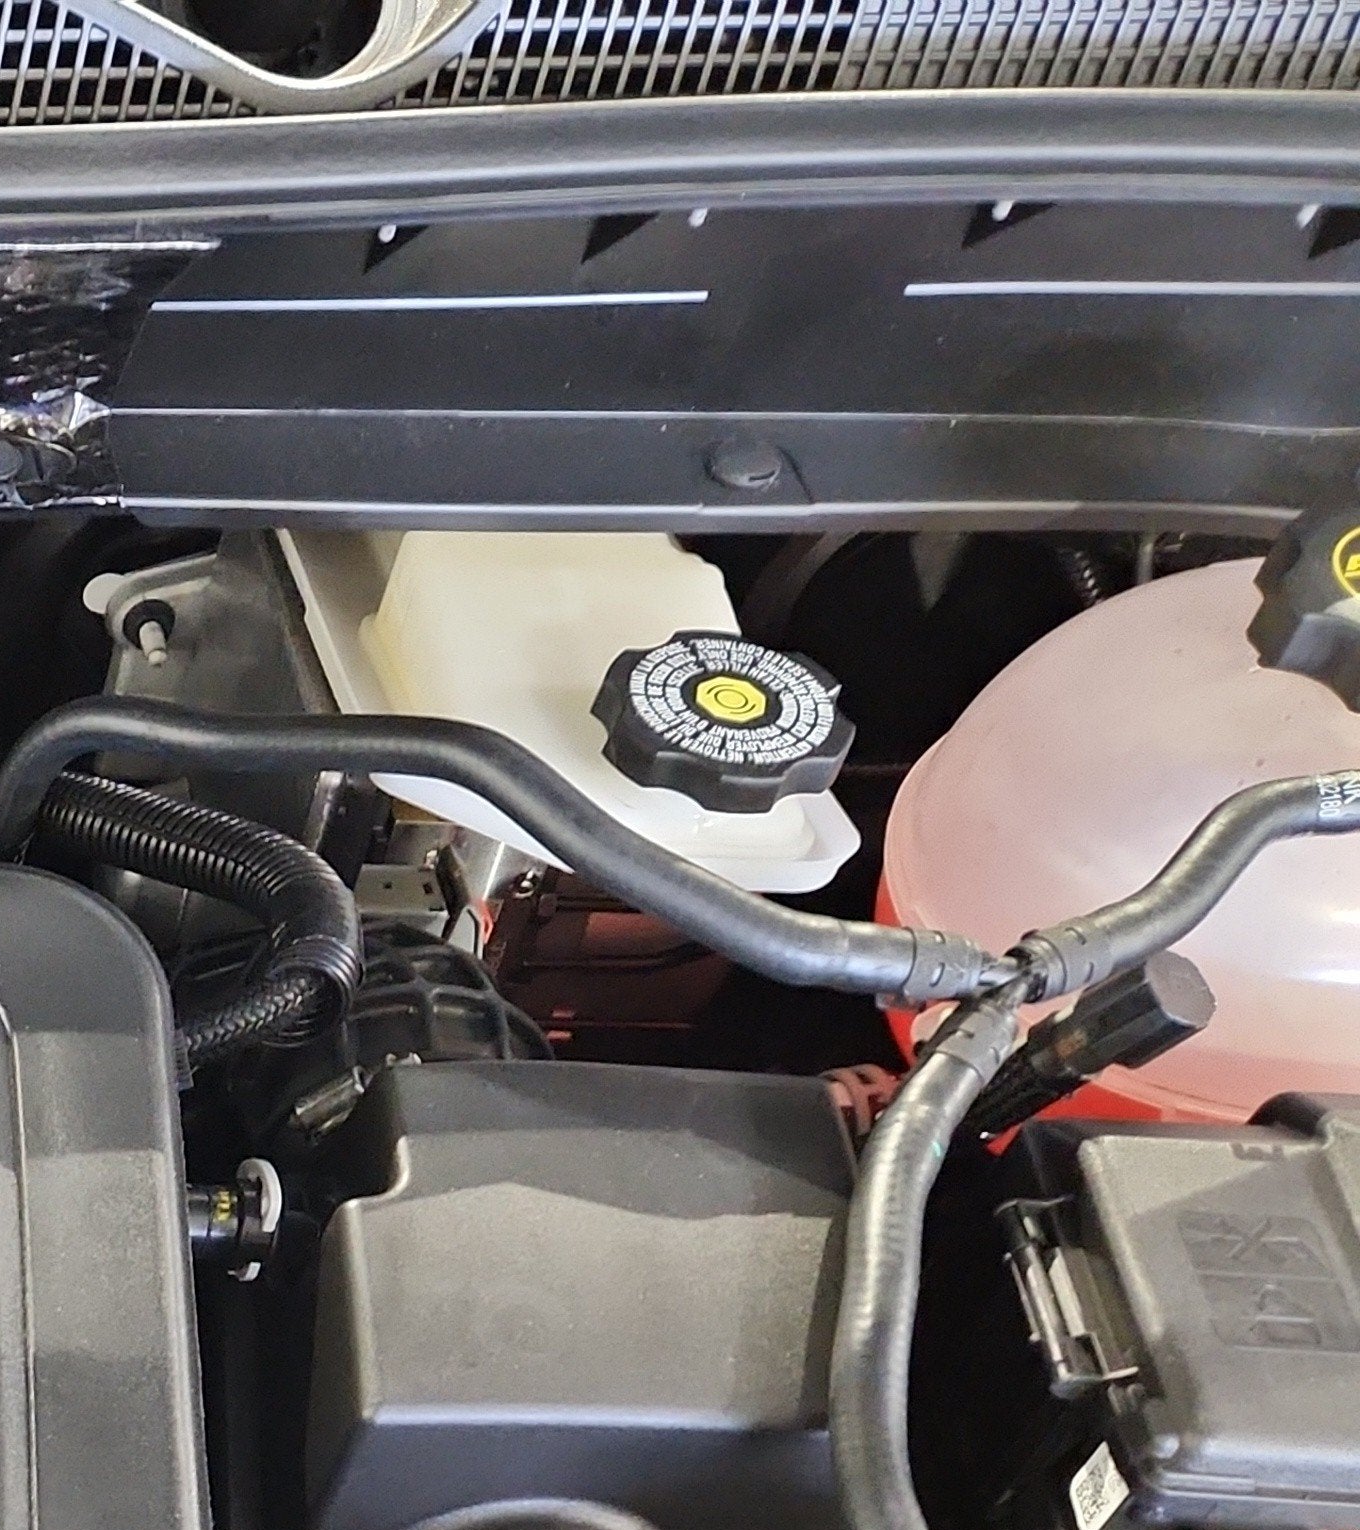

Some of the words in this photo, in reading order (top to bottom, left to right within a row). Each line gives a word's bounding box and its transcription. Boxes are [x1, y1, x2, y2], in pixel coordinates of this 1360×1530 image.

[695, 649, 728, 660] ONLY
[730, 650, 754, 664] USE
[762, 648, 809, 677] SEALED
[704, 660, 750, 675] FILLER
[659, 728, 683, 743] LE
[693, 730, 722, 747] QUE
[707, 722, 783, 740] PROVENANT
[676, 735, 745, 764] NETTOYER
